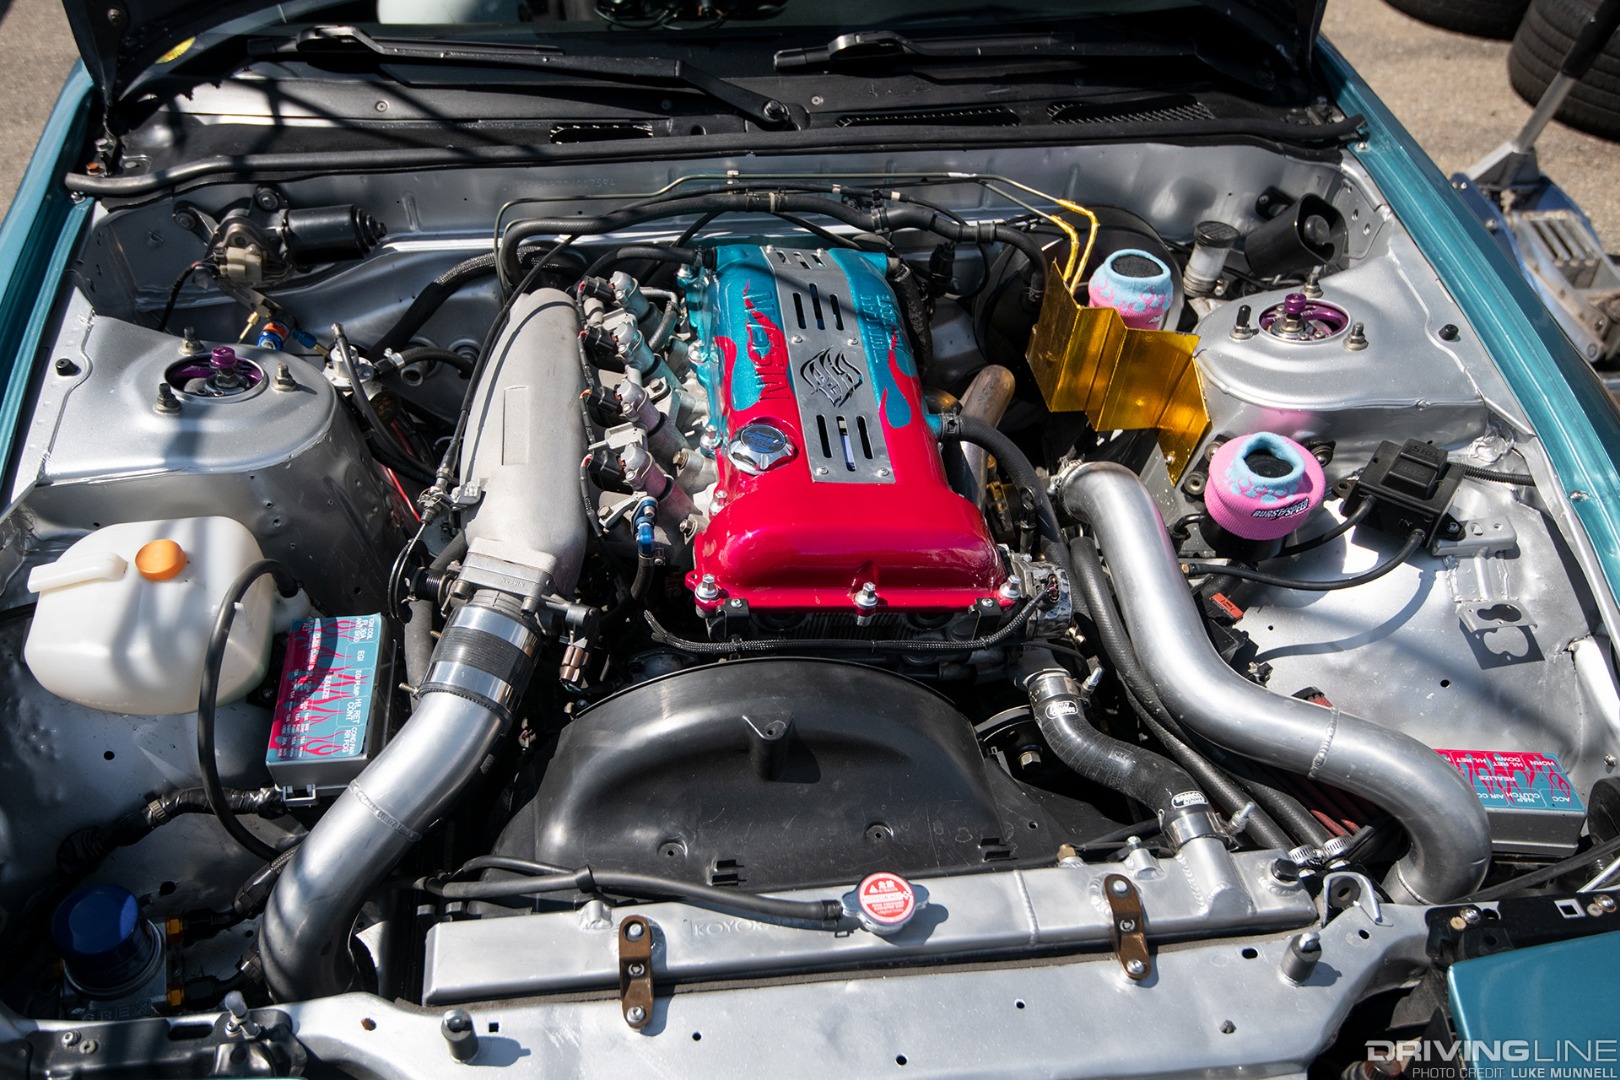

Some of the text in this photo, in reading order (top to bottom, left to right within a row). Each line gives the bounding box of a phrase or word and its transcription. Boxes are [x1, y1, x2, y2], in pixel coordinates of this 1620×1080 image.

[743, 289, 791, 401] NISSAN
[357, 650, 365, 661] EGI
[322, 673, 333, 699] EALIZE
[346, 702, 355, 721] CONT
[353, 710, 361, 724] RET
[1529, 759, 1554, 767] HORN
[1505, 791, 1541, 799] CLUTCH
